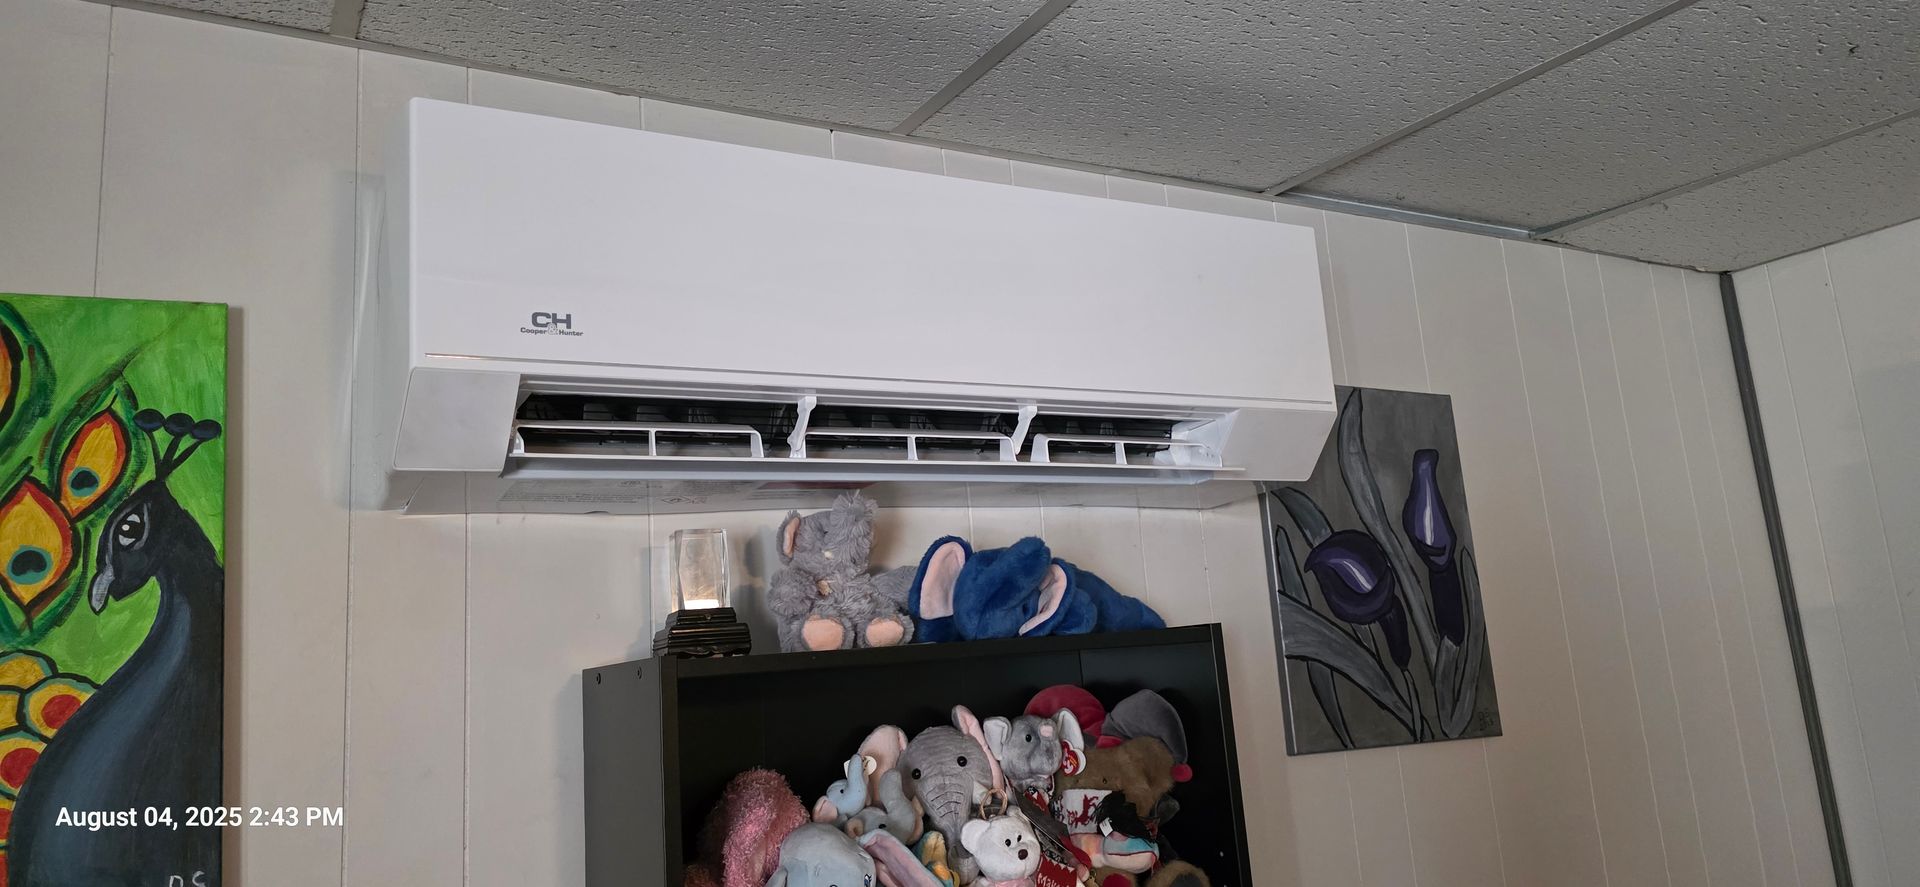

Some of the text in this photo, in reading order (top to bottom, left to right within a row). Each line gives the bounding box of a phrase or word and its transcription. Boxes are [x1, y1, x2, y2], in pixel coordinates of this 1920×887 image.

[531, 312, 572, 329] CH
[520, 327, 547, 335] Cooper
[547, 323, 558, 335] &
